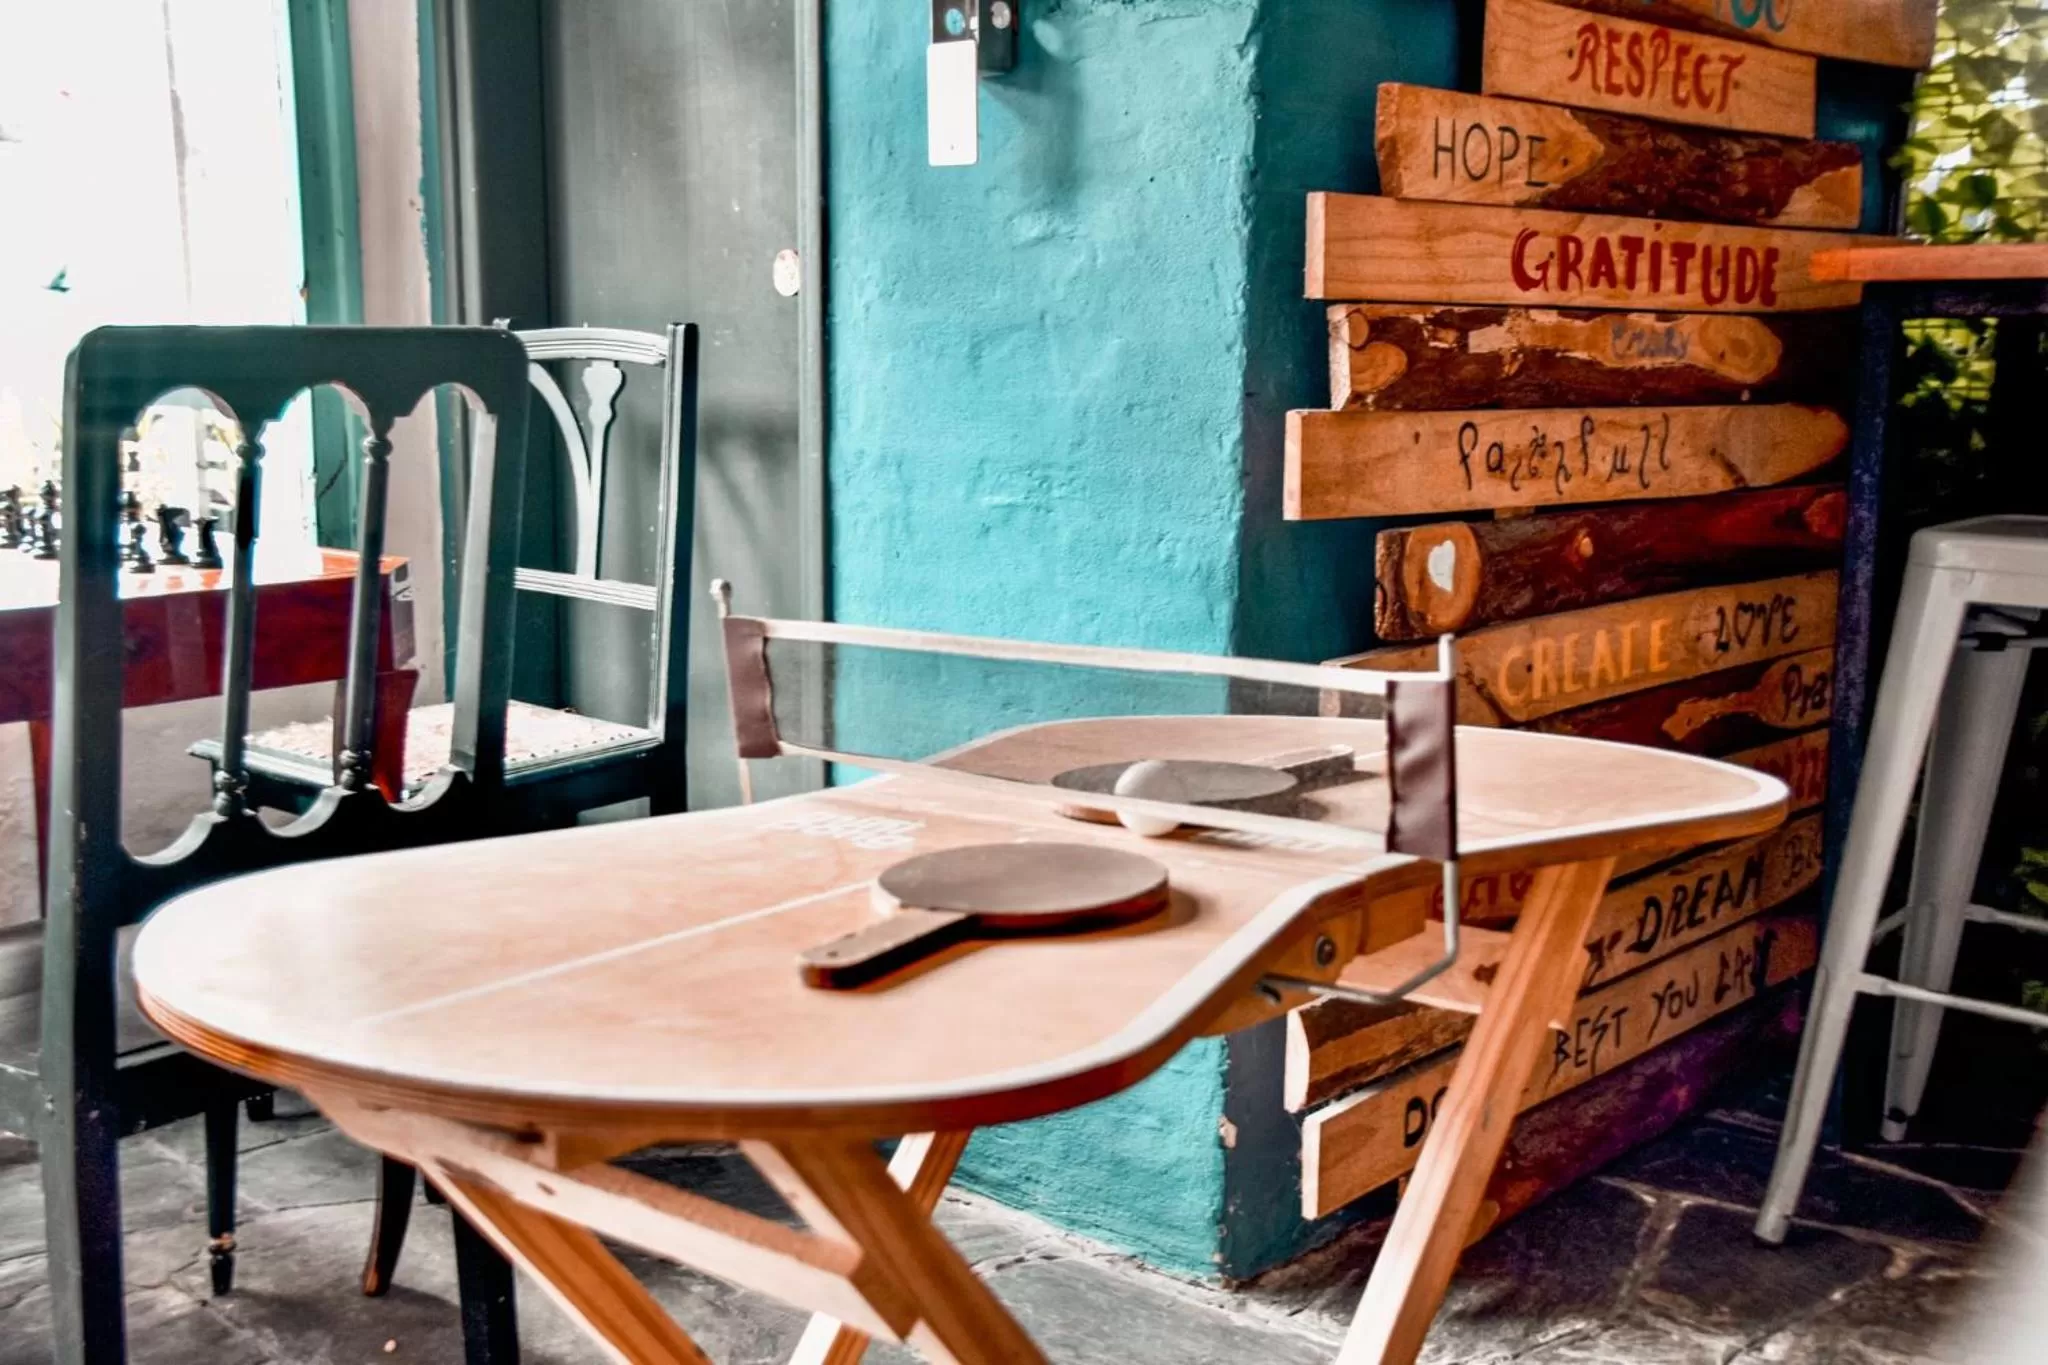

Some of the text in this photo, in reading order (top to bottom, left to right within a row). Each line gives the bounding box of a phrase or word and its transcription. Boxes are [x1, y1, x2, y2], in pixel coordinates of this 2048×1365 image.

[1568, 22, 1746, 113] RESPECT
[1433, 115, 1549, 188] HOPE
[1499, 593, 1799, 704] CREATE LOVE
[1624, 850, 1768, 954] DREAM
[1545, 1004, 1629, 1092] BEST
